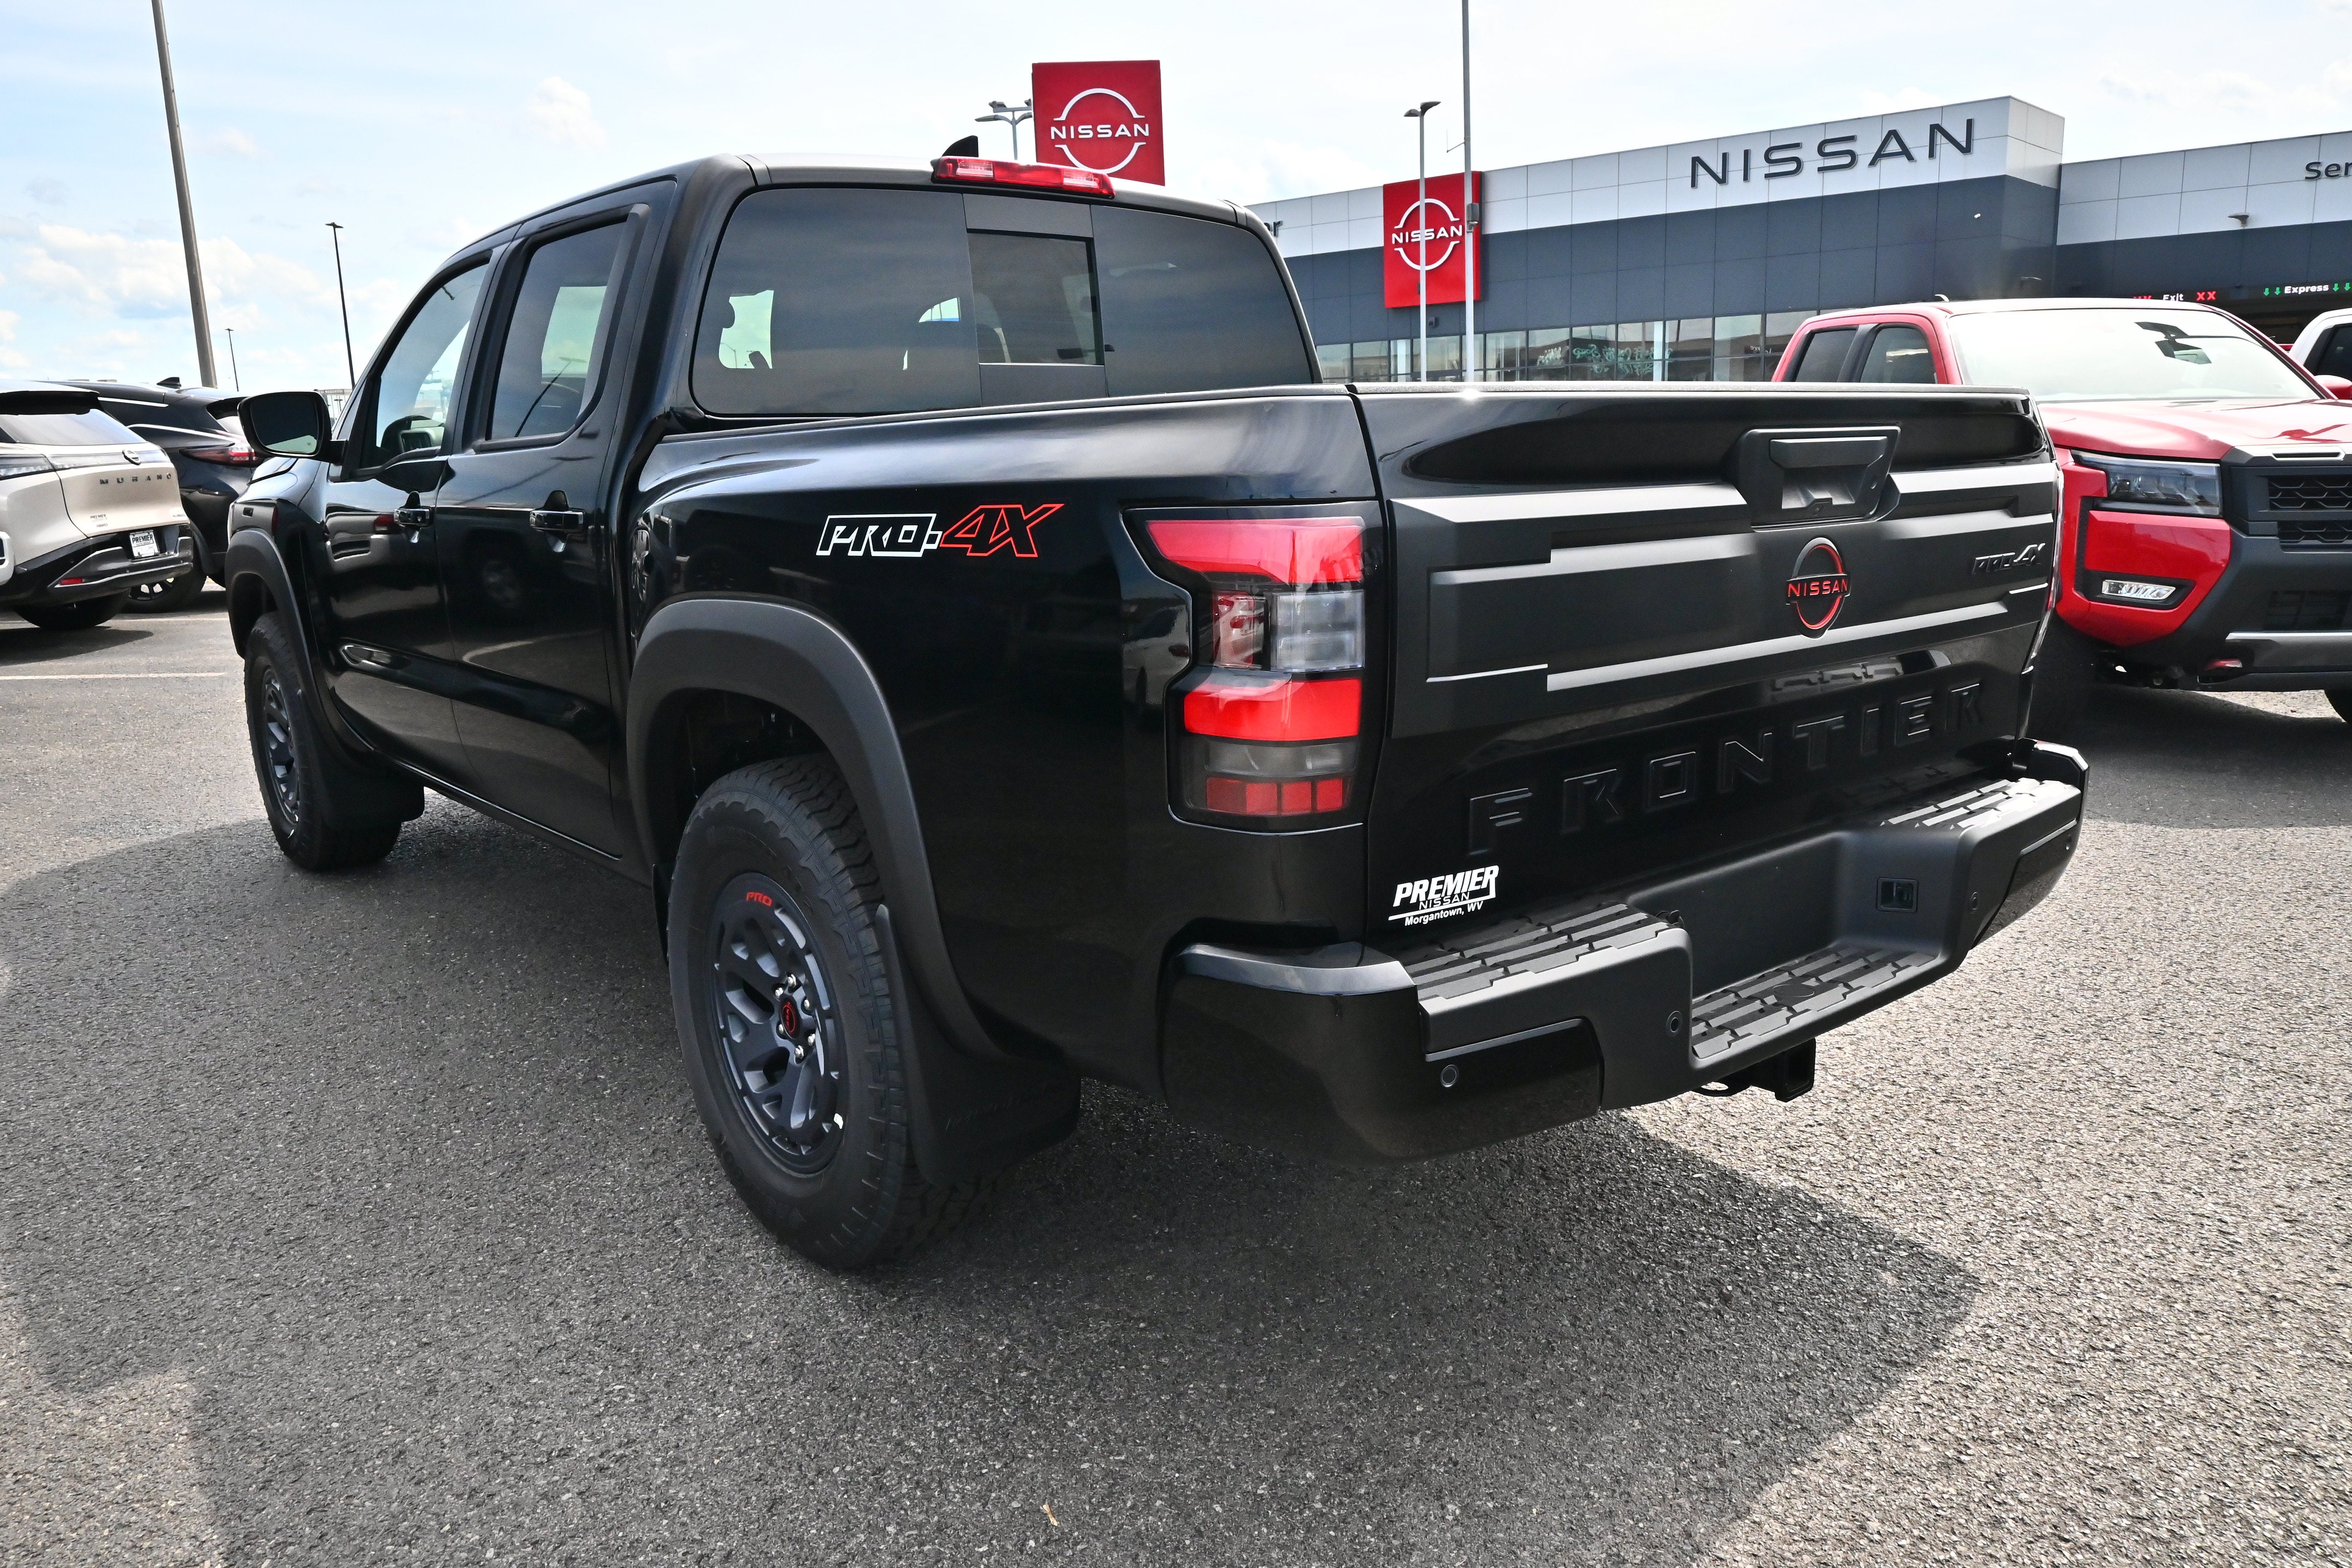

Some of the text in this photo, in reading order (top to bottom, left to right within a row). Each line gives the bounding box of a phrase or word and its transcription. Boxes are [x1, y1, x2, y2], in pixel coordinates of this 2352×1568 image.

[1051, 124, 1149, 140] NISSAN
[1690, 118, 1974, 188] NISSAN
[1392, 225, 1462, 244] NISSAN
[2163, 293, 2183, 301] Exit
[2284, 285, 2329, 294] Express
[100, 473, 171, 484] MURANO
[132, 534, 153, 544] PREMIER
[816, 504, 1064, 557] PRO-4X
[1788, 578, 1848, 597] NISSAN
[1467, 683, 1982, 858] FRONTIER
[1393, 865, 1499, 907] PREMIER
[746, 892, 773, 907] PRO
[1419, 891, 1470, 910] NISSAN
[1405, 901, 1484, 926] Morgantown, WV
